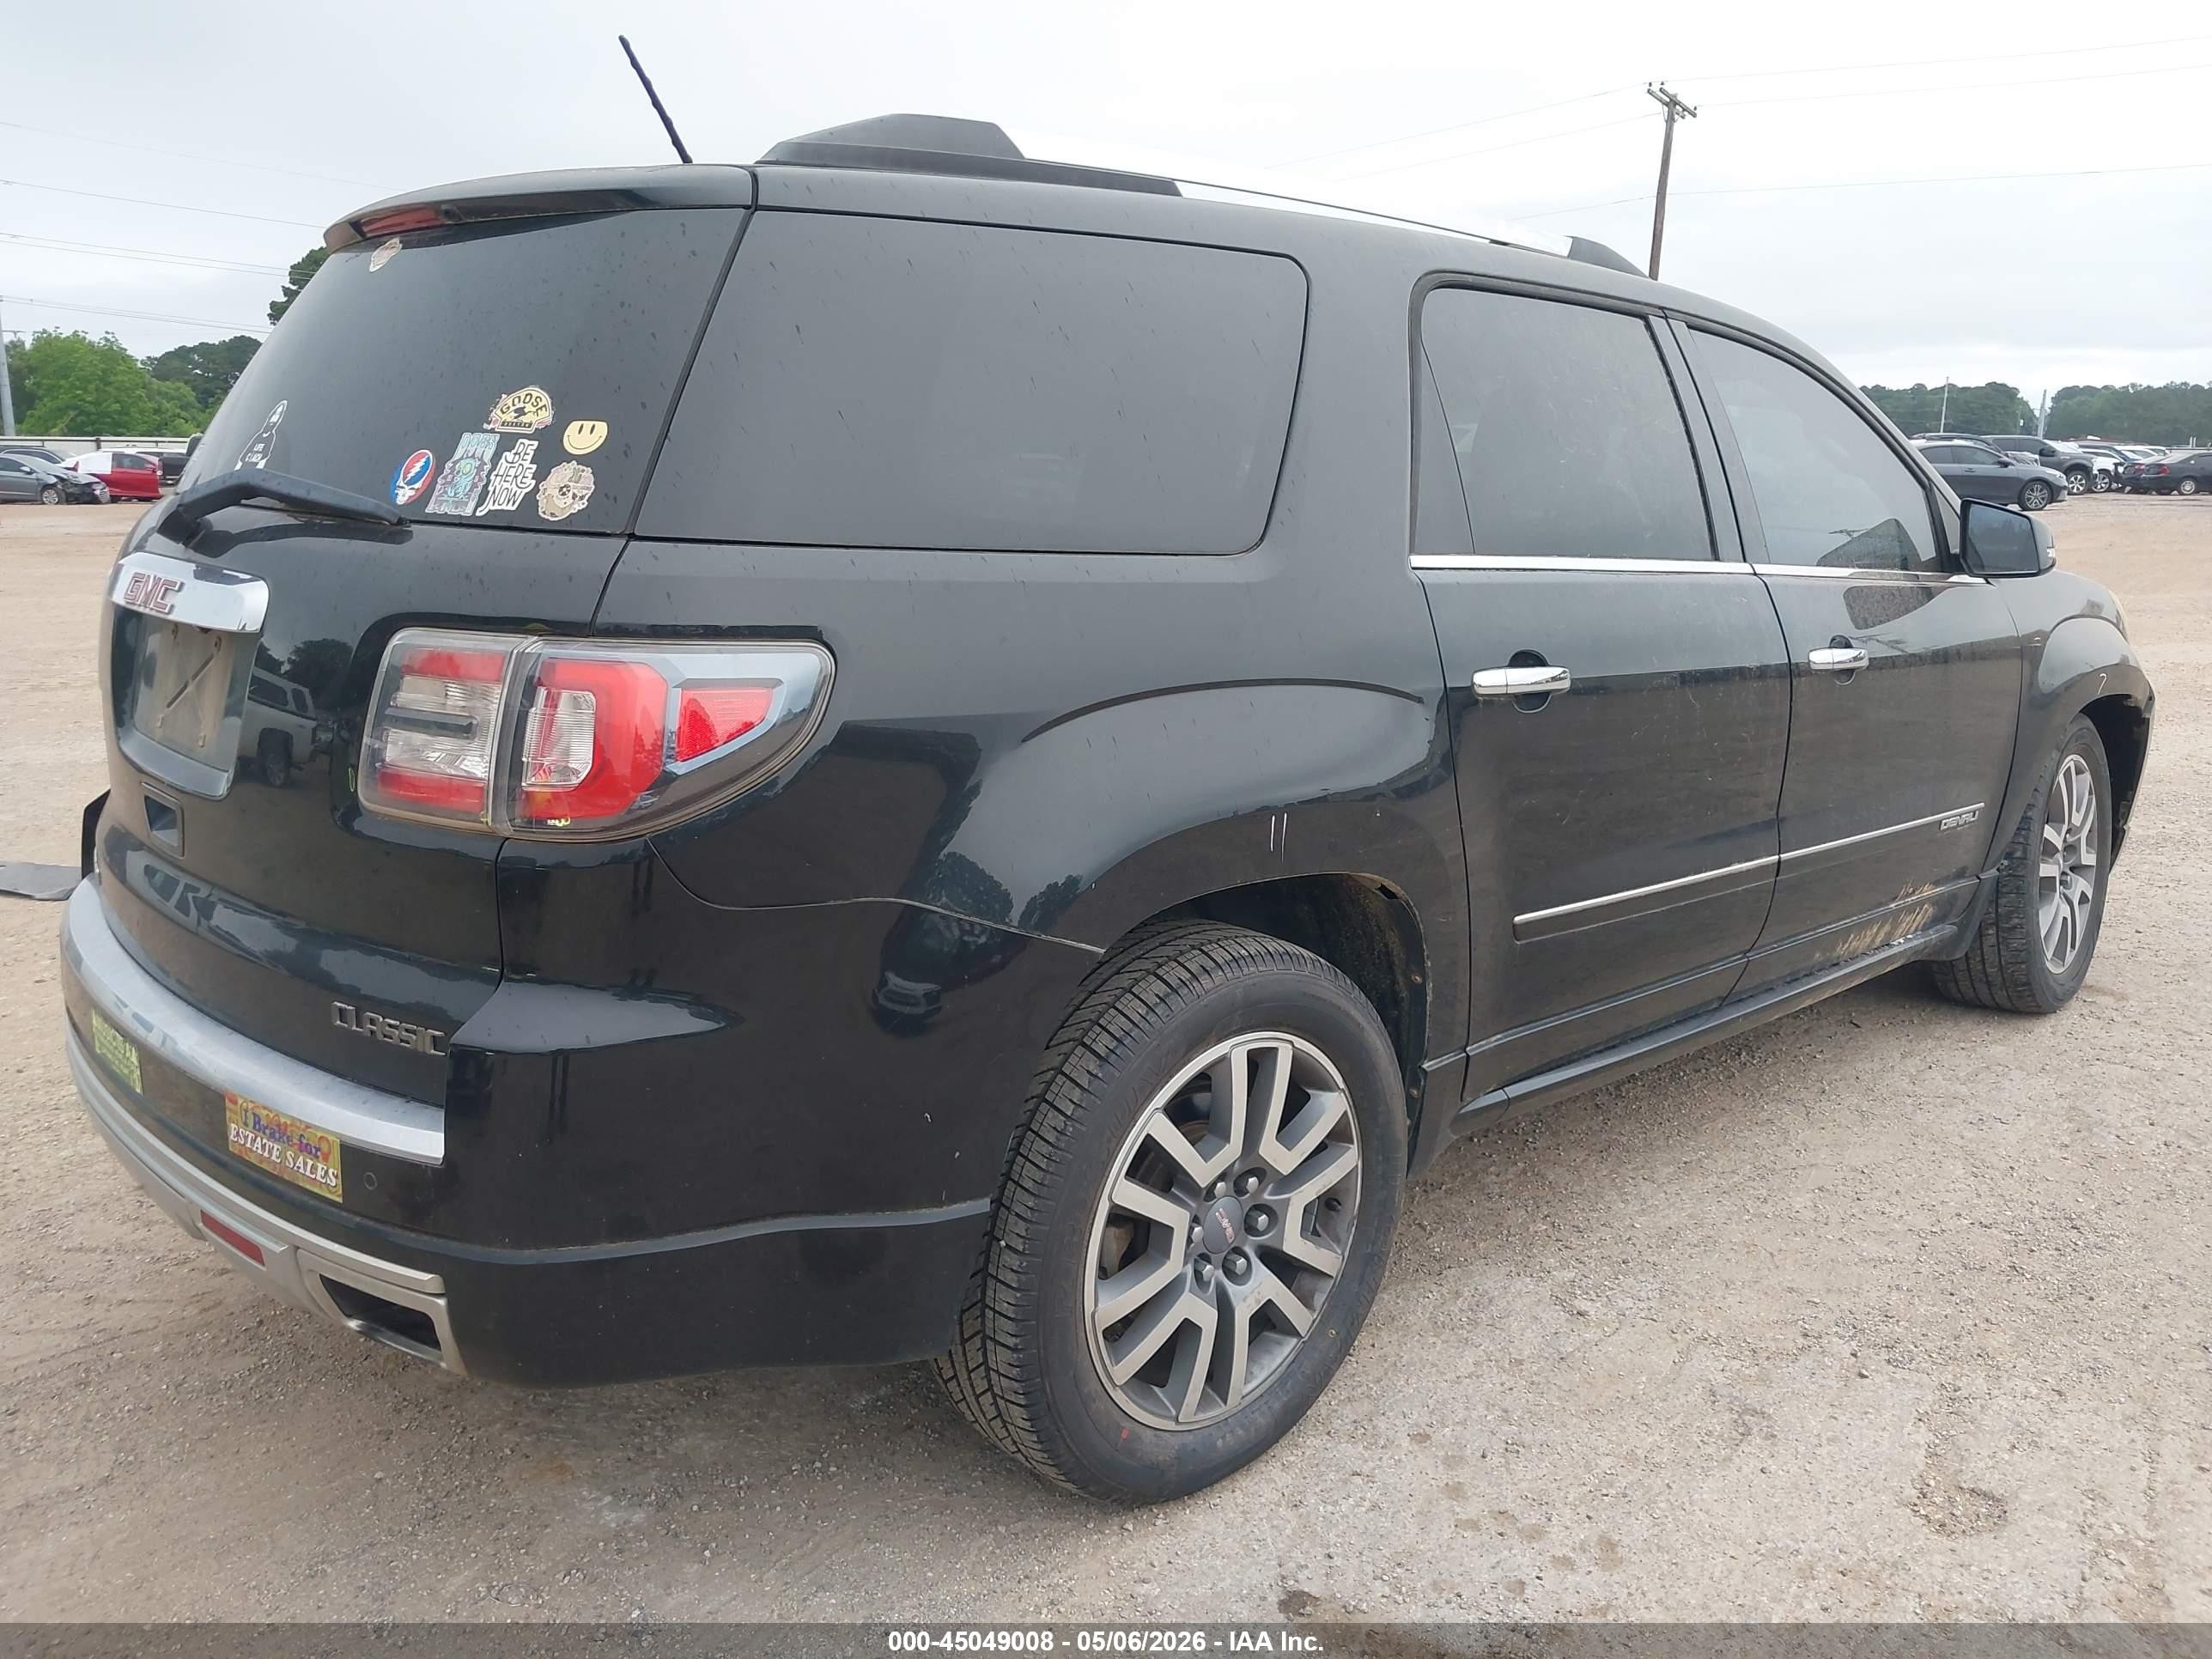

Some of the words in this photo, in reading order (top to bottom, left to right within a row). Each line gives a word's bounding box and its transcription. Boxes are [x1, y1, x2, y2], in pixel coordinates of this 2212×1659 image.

[505, 441, 535, 464] BE
[492, 463, 534, 489] HERE
[482, 486, 523, 510] NOW
[124, 572, 182, 615] GMC
[1941, 810, 1979, 831] DENALI
[331, 1000, 447, 1057] CLASSIC
[252, 1112, 291, 1146] Brake
[298, 1133, 321, 1159] for
[229, 1122, 282, 1164] ESTATE
[285, 1150, 337, 1187] SALES
